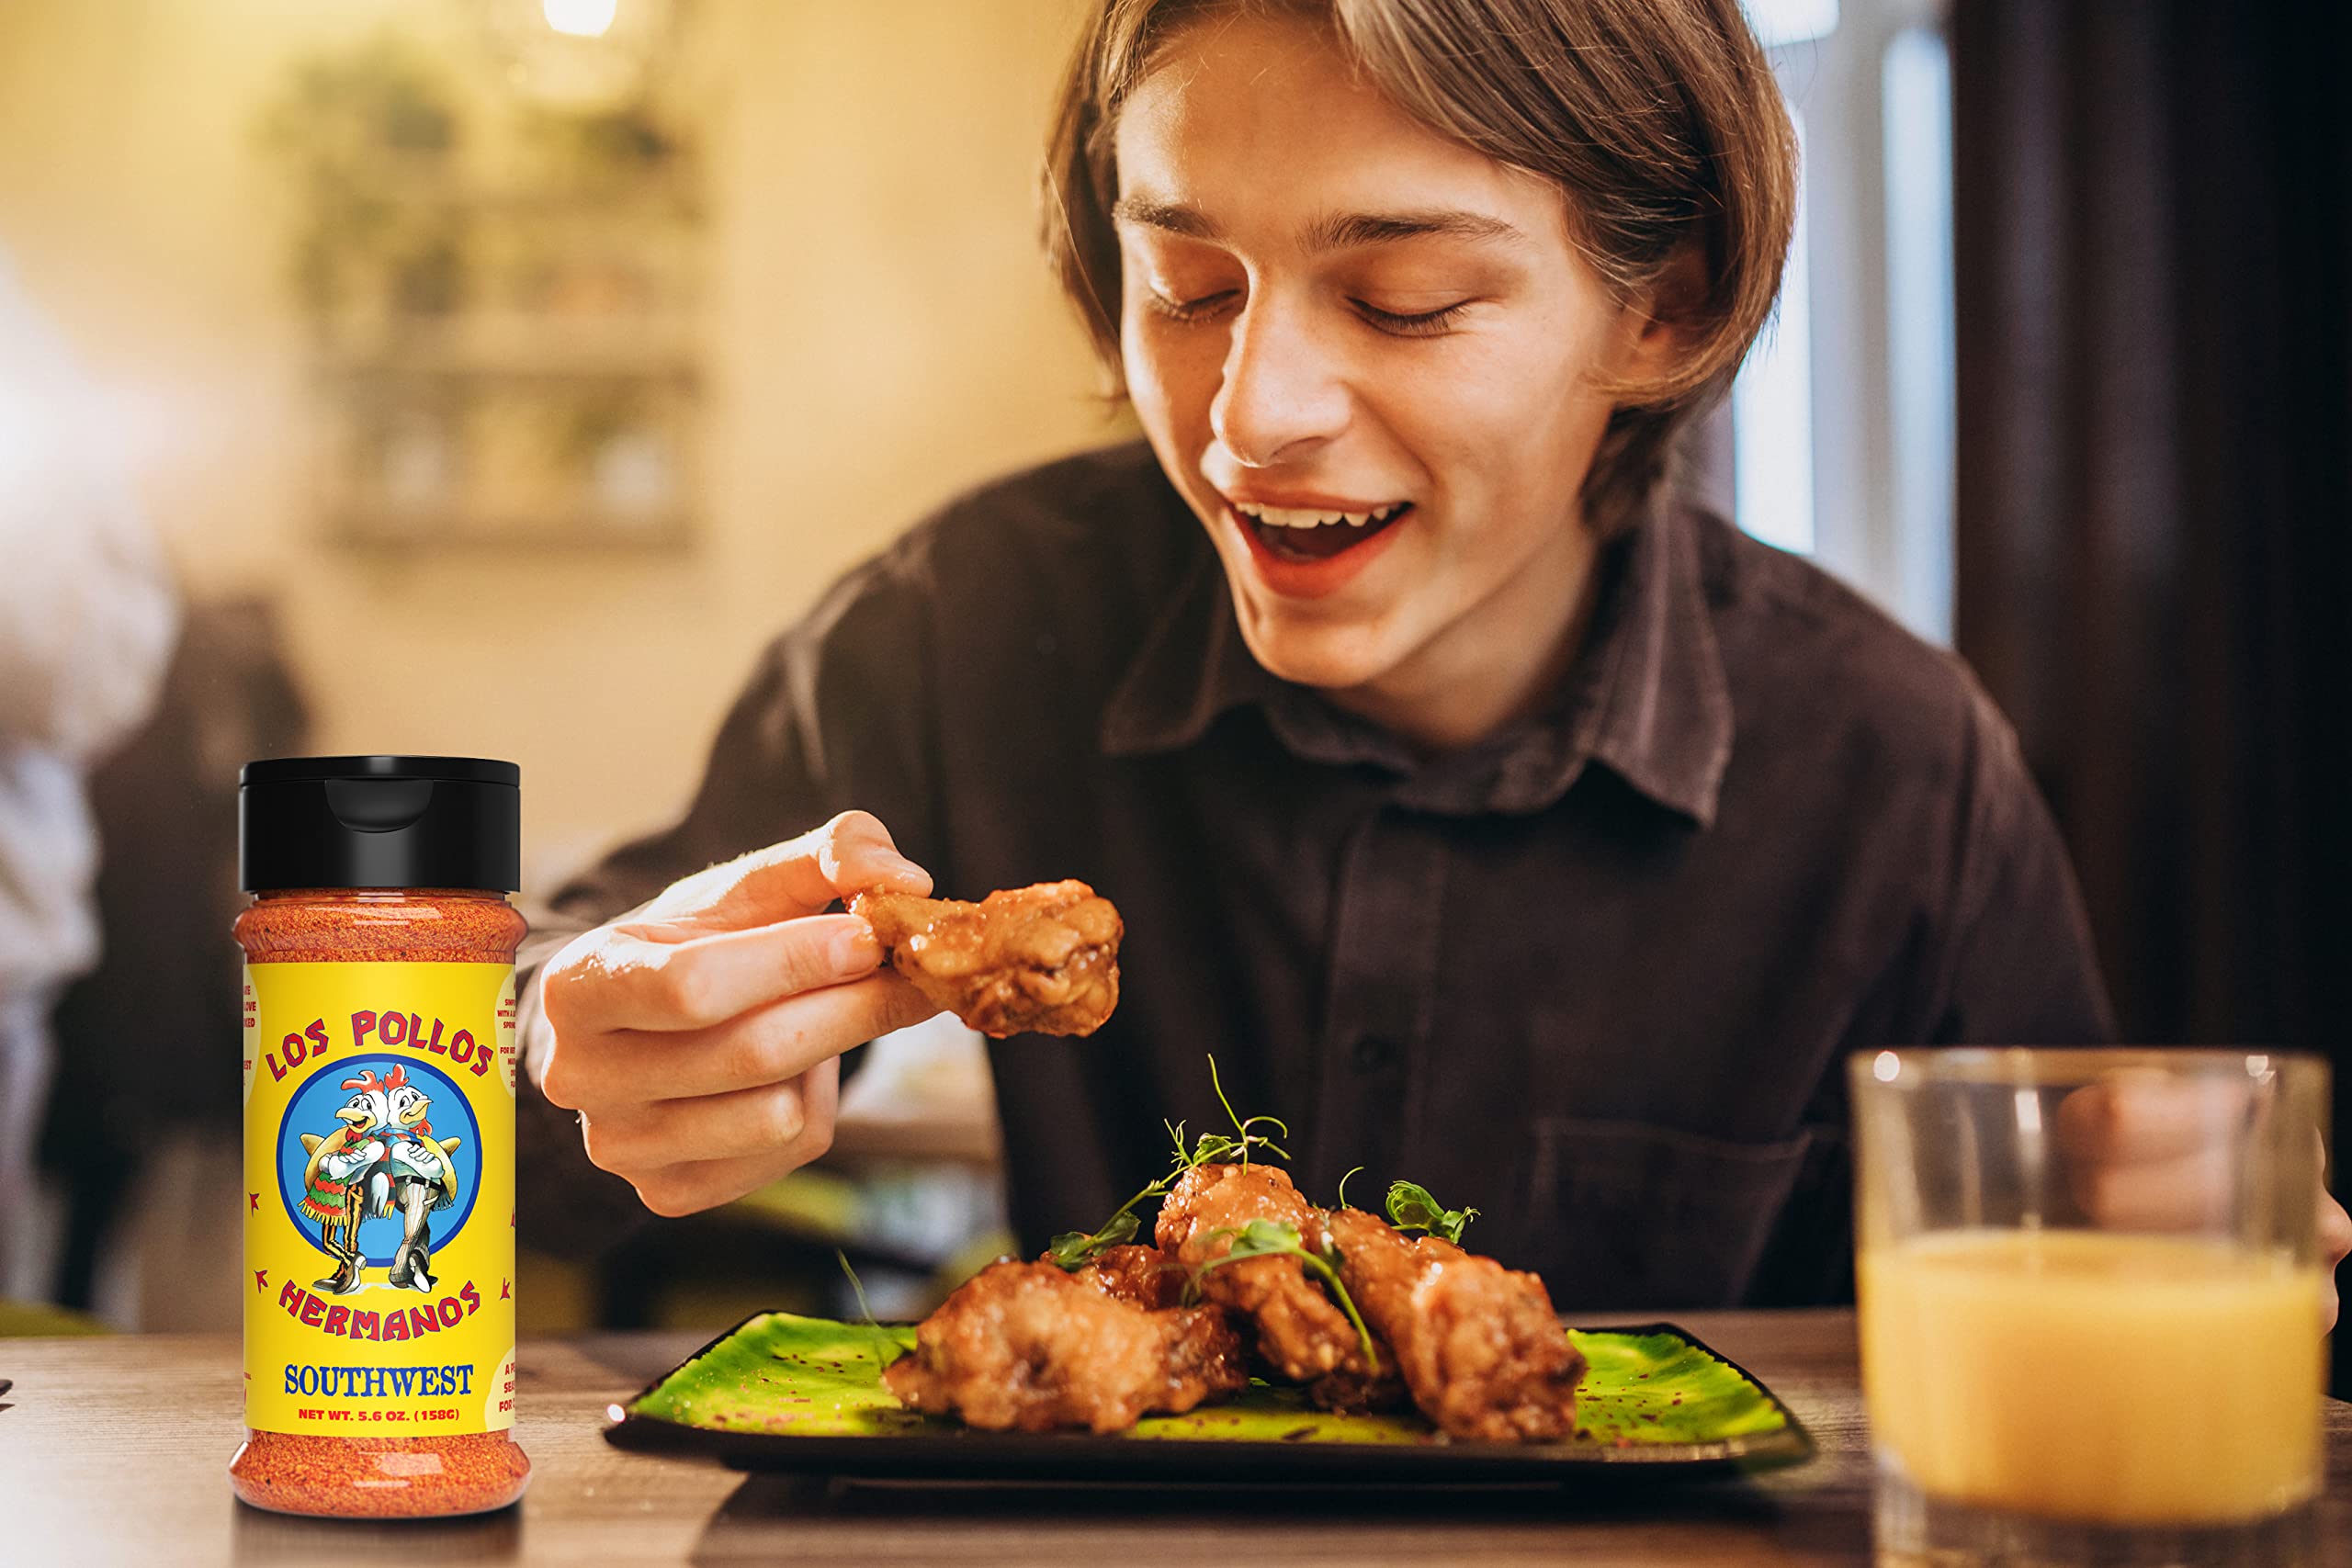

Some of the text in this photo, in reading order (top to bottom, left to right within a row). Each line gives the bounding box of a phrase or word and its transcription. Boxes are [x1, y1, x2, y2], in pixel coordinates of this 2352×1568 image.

[244, 1001, 256, 1011] OVE
[266, 1010, 494, 1082] LOS POLLOS
[278, 1280, 481, 1341] HERMANOS
[285, 1364, 474, 1397] SOUTHWEST
[299, 1409, 459, 1422] NET WT. 5.6 OZ. (158G)
[499, 1399, 512, 1412] FOR
